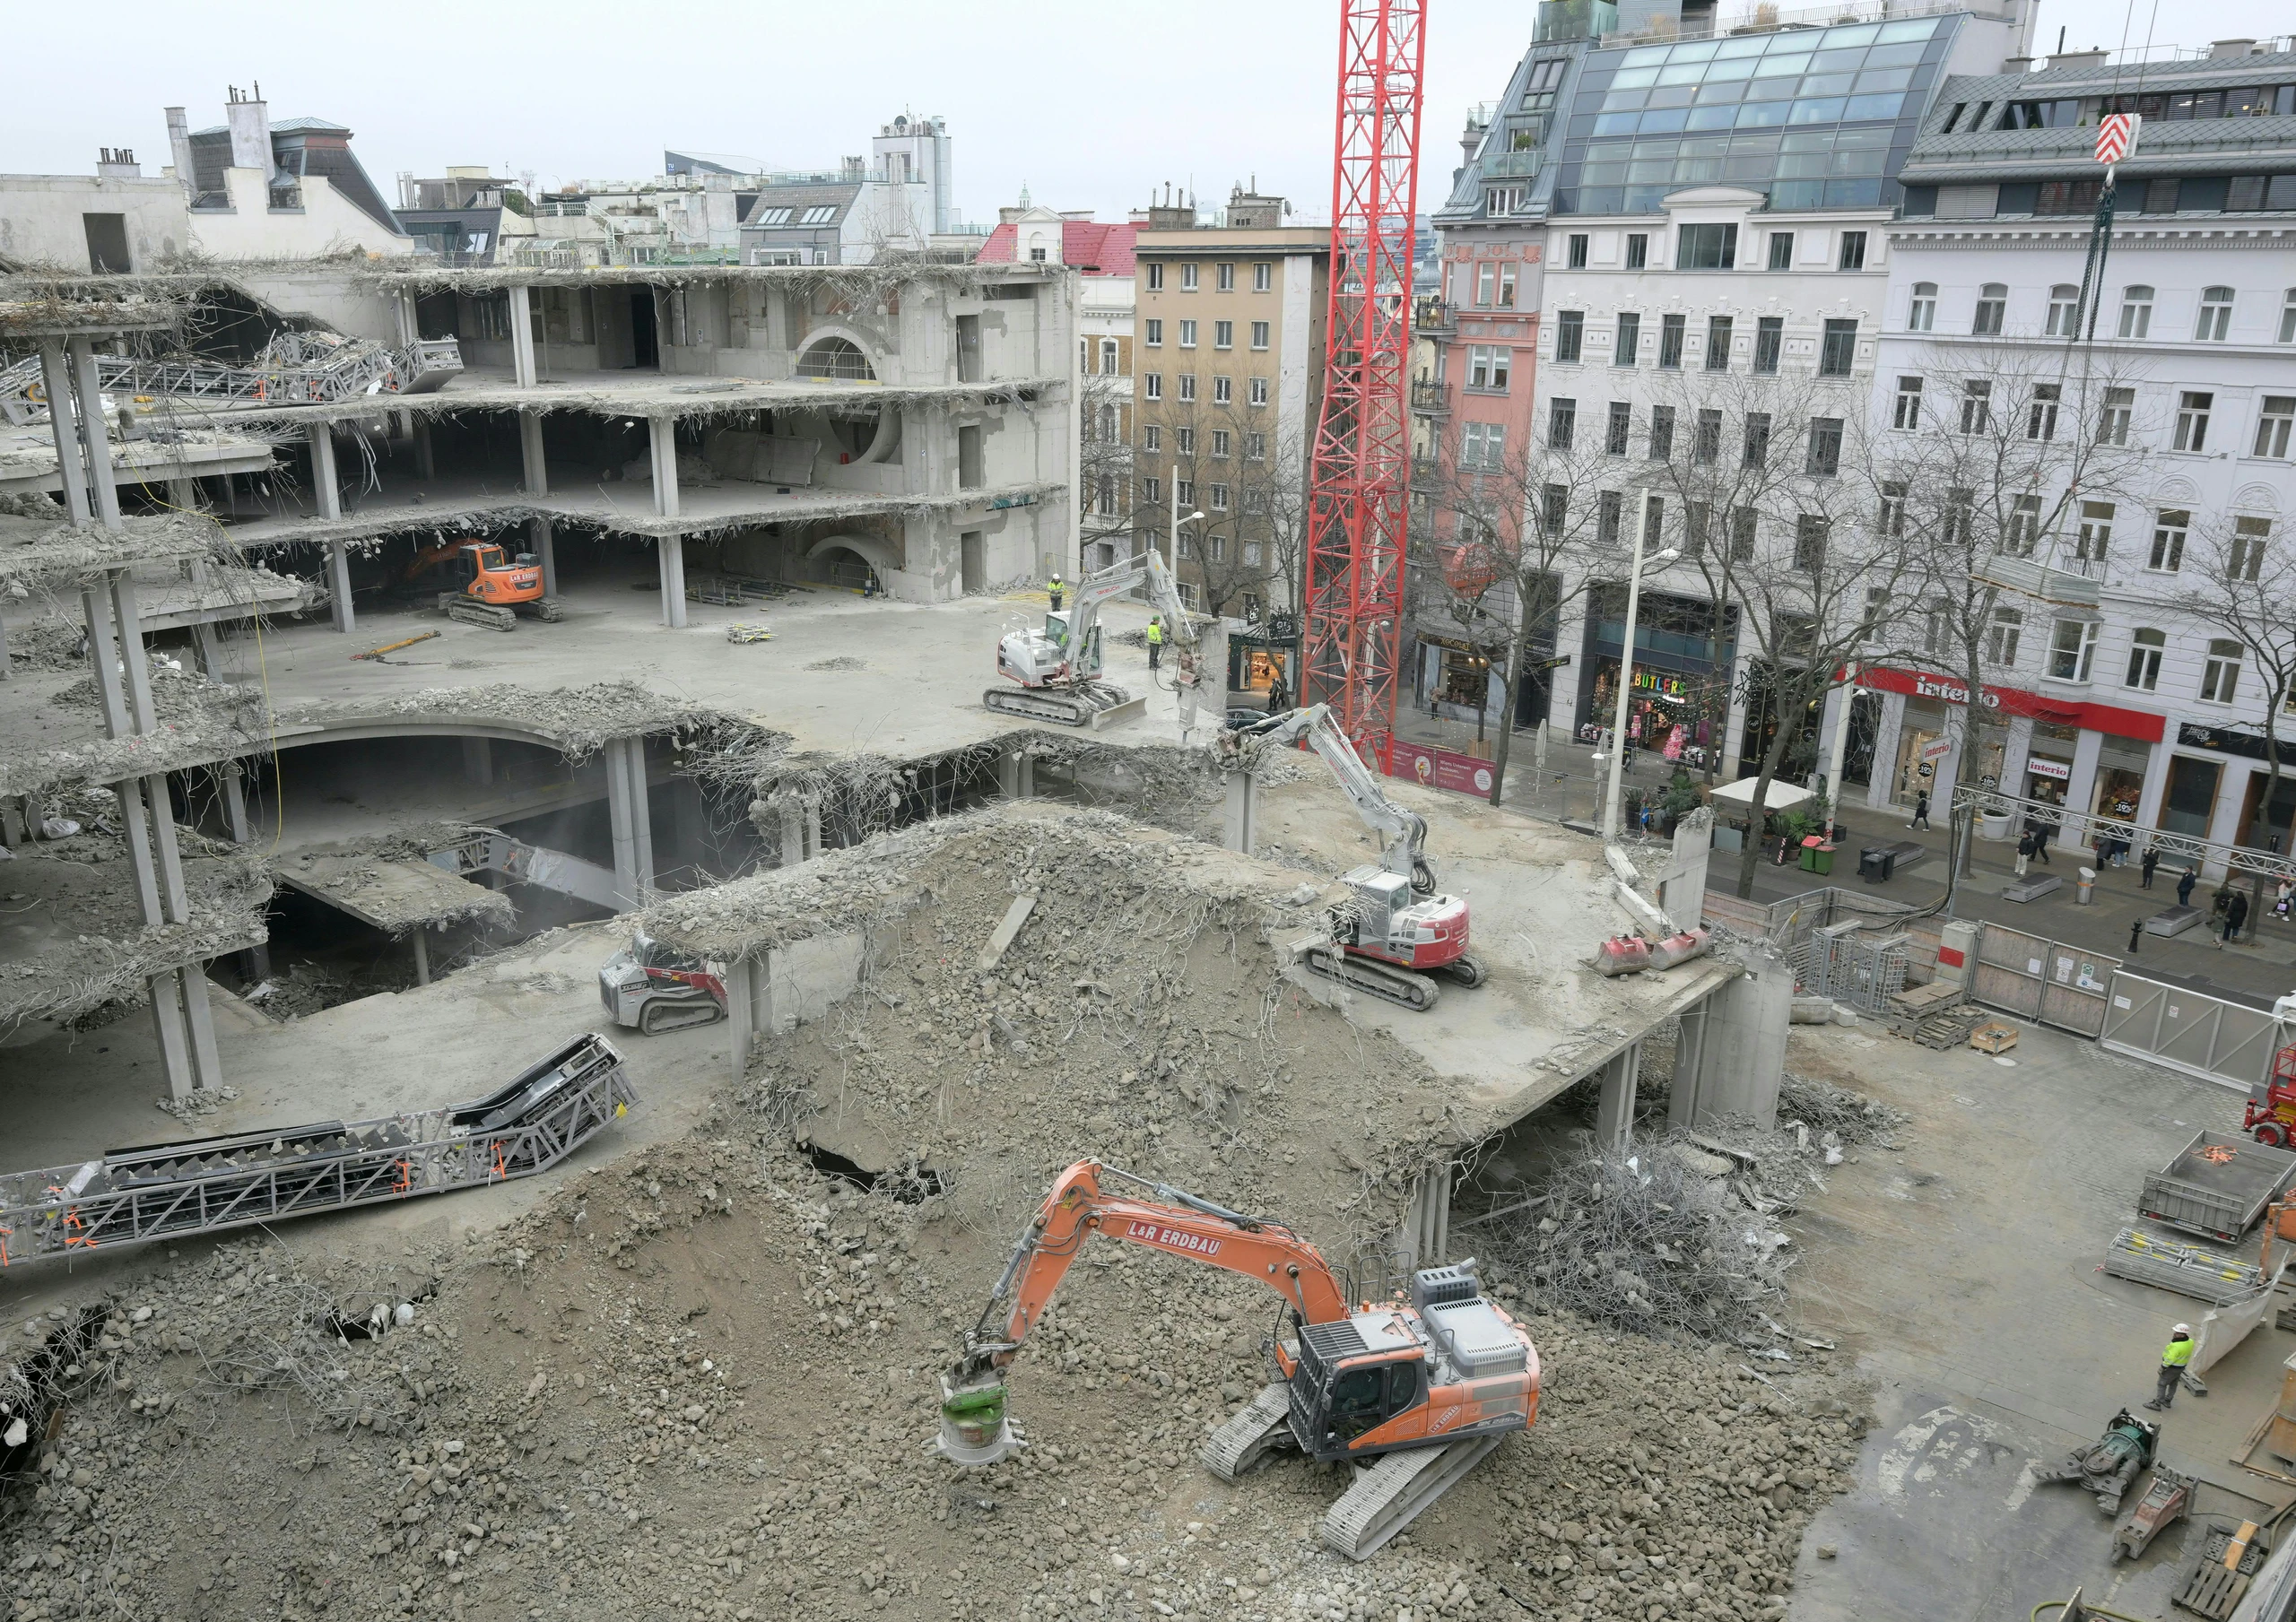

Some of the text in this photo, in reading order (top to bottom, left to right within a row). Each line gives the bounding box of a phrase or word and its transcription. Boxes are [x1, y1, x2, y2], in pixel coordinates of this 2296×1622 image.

[1634, 673, 1686, 696] BUTLERS
[1925, 742, 1950, 758] interio
[2031, 761, 2067, 776] interio
[1128, 1222, 1220, 1254] L&R ERDBAU
[1440, 1405, 1459, 1425] ERDBAU
